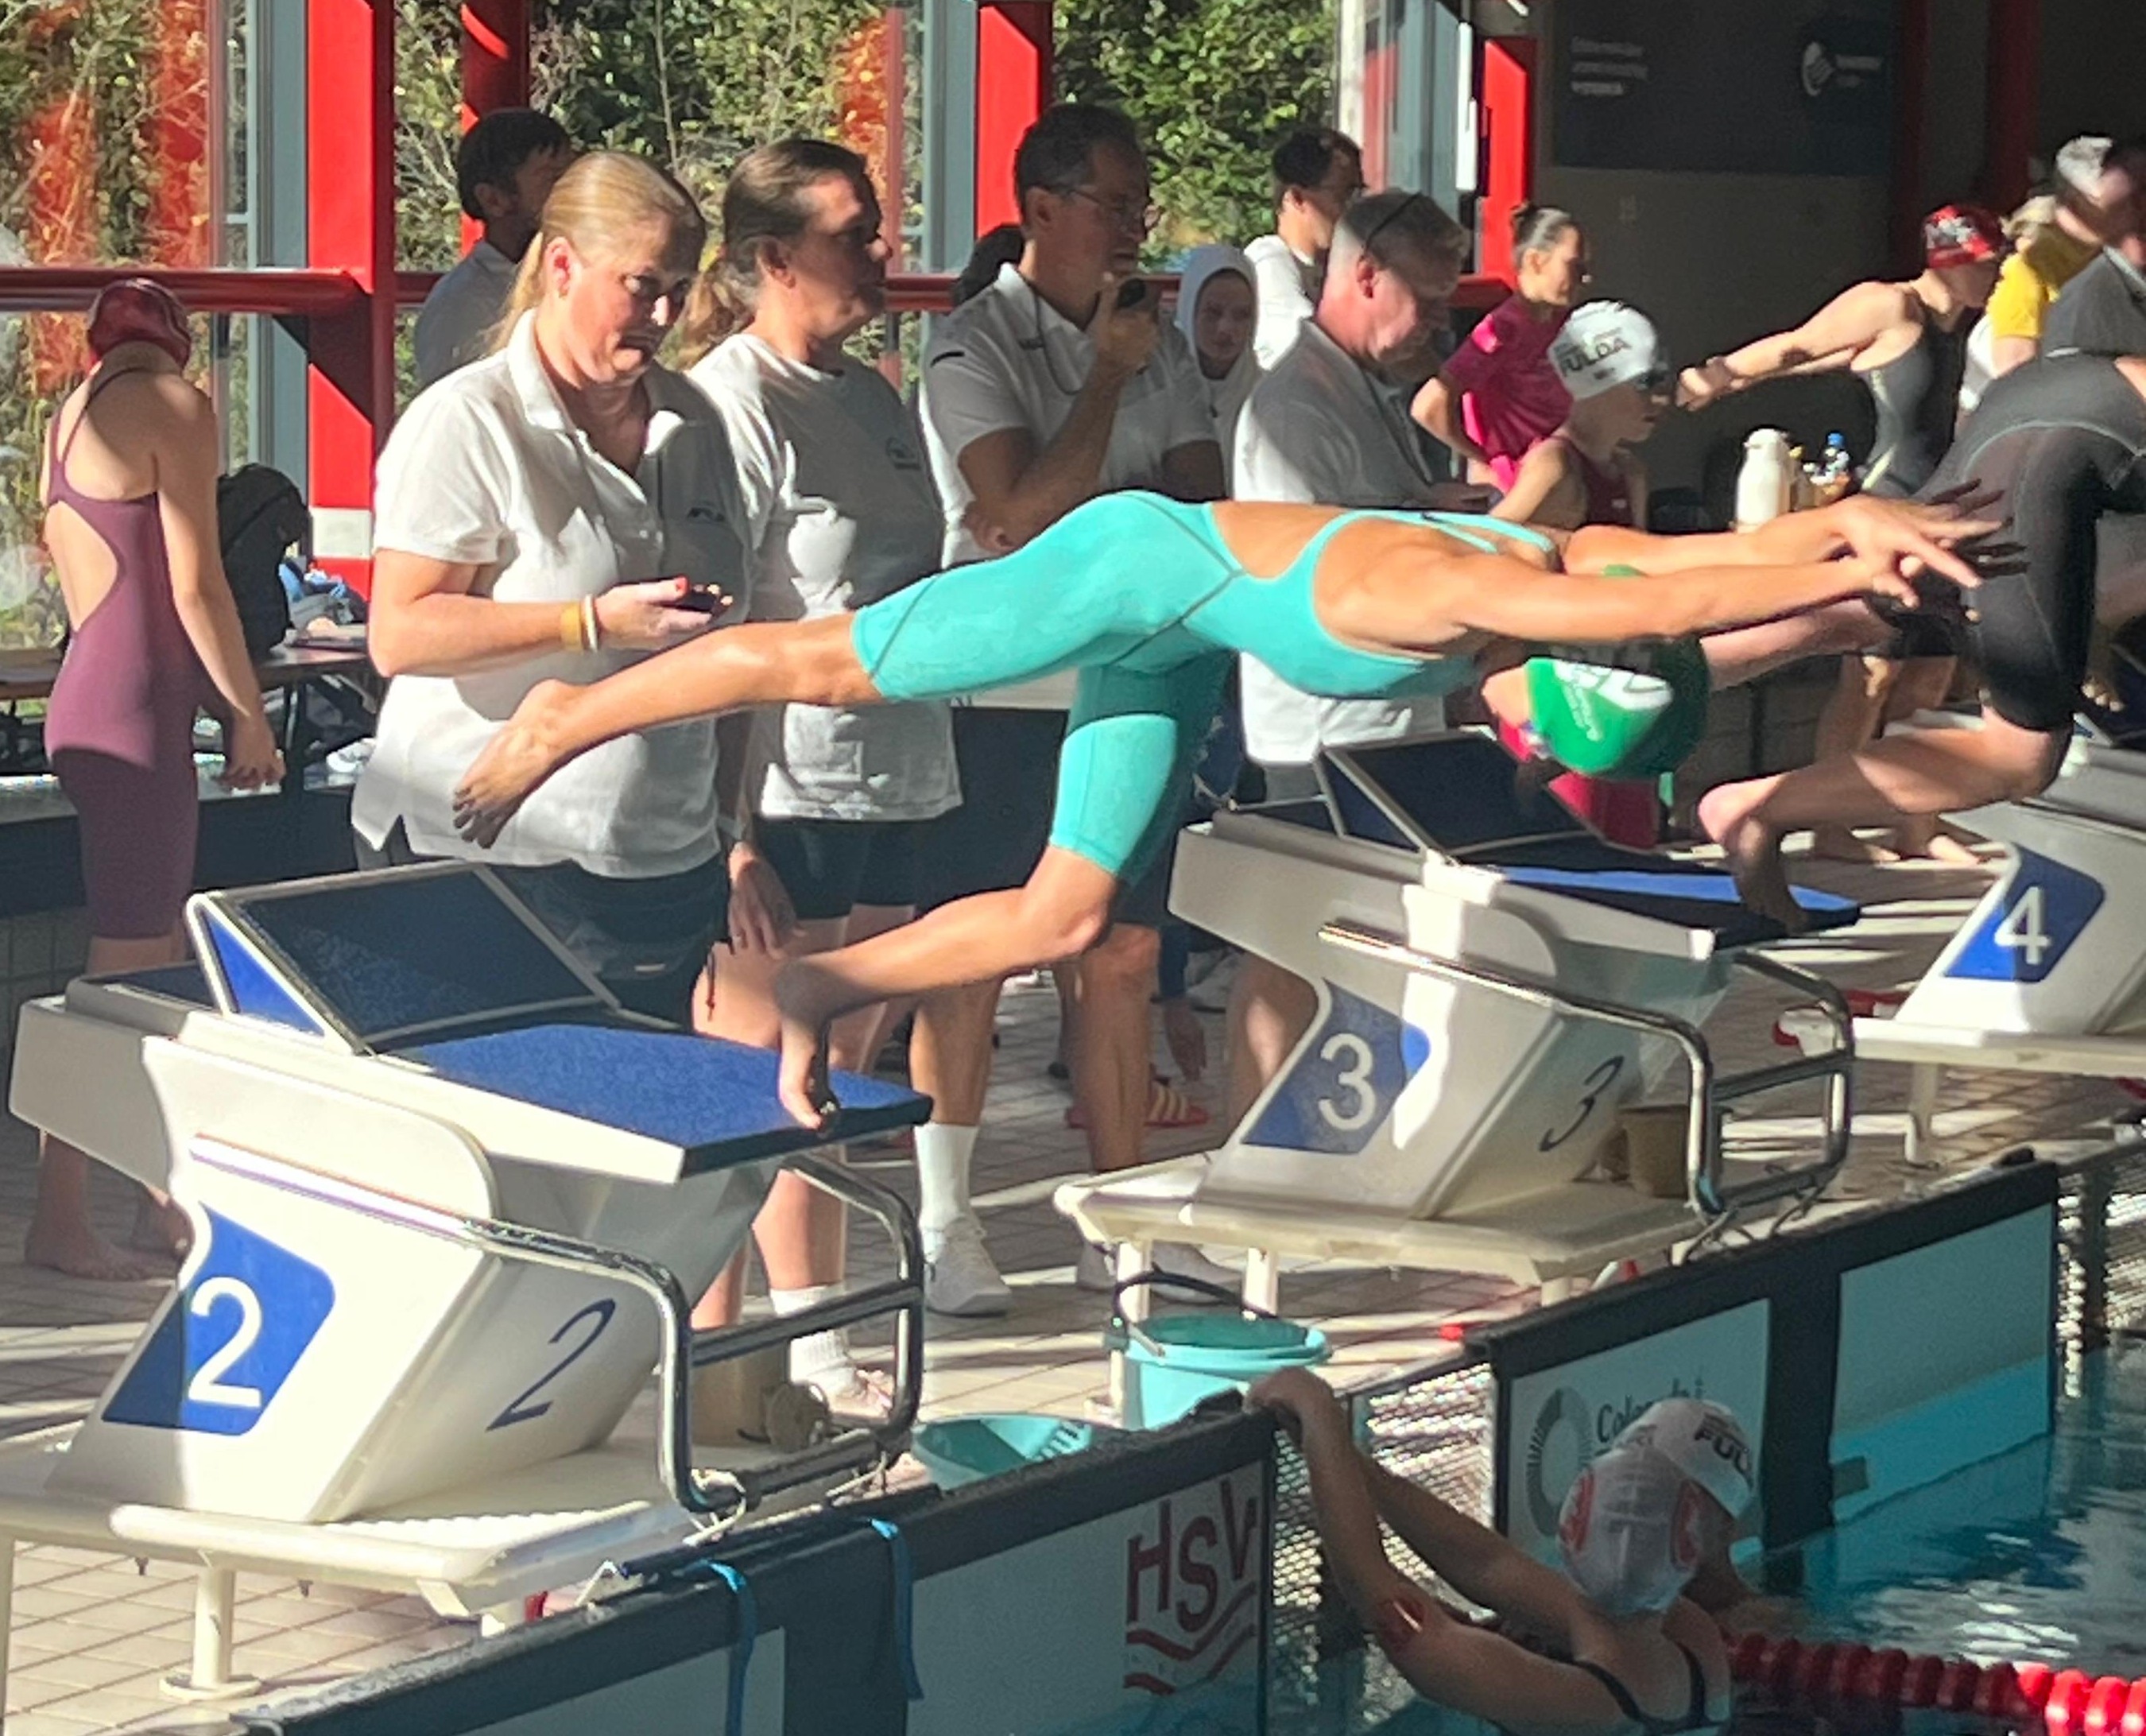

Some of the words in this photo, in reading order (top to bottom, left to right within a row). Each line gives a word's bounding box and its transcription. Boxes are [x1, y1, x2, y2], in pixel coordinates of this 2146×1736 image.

[1994, 885, 2051, 965] 4
[1318, 1033, 1377, 1131] 3
[1539, 1055, 1625, 1152] 3
[188, 1277, 262, 1408] 2
[485, 1298, 617, 1431] 2
[1126, 1478, 1257, 1633] HSV
